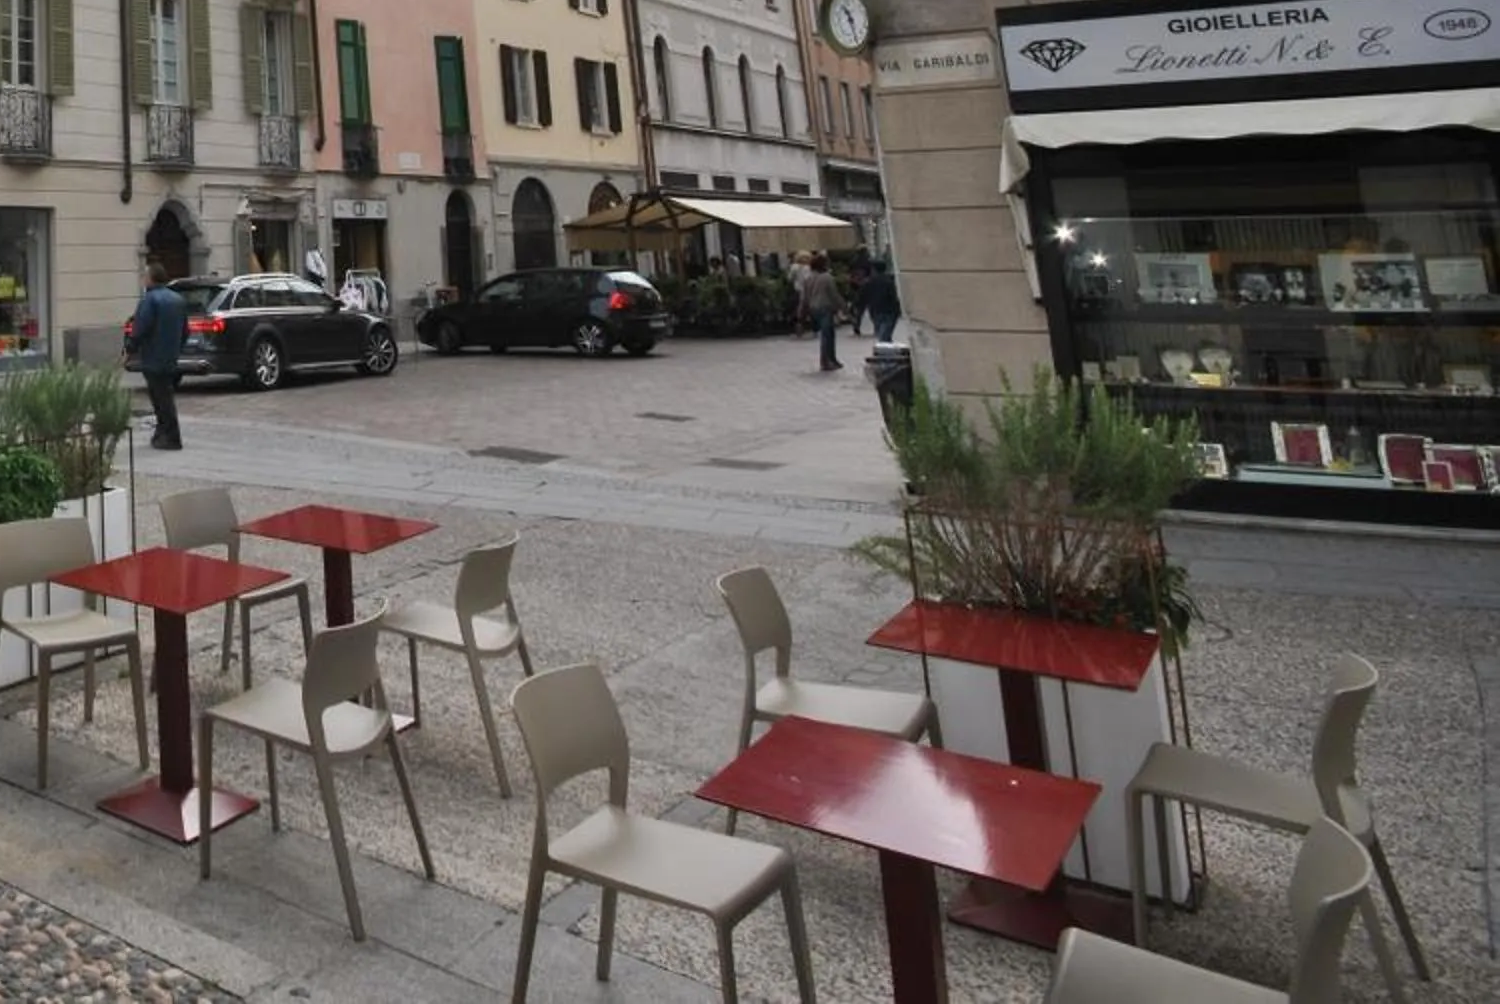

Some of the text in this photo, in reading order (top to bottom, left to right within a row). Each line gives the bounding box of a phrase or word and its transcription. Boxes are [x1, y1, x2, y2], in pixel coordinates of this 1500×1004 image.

[1167, 7, 1329, 34] GIOIELLERIA
[879, 52, 990, 72] VIA GARIBALDI
[1113, 43, 1251, 75] Lionetti
